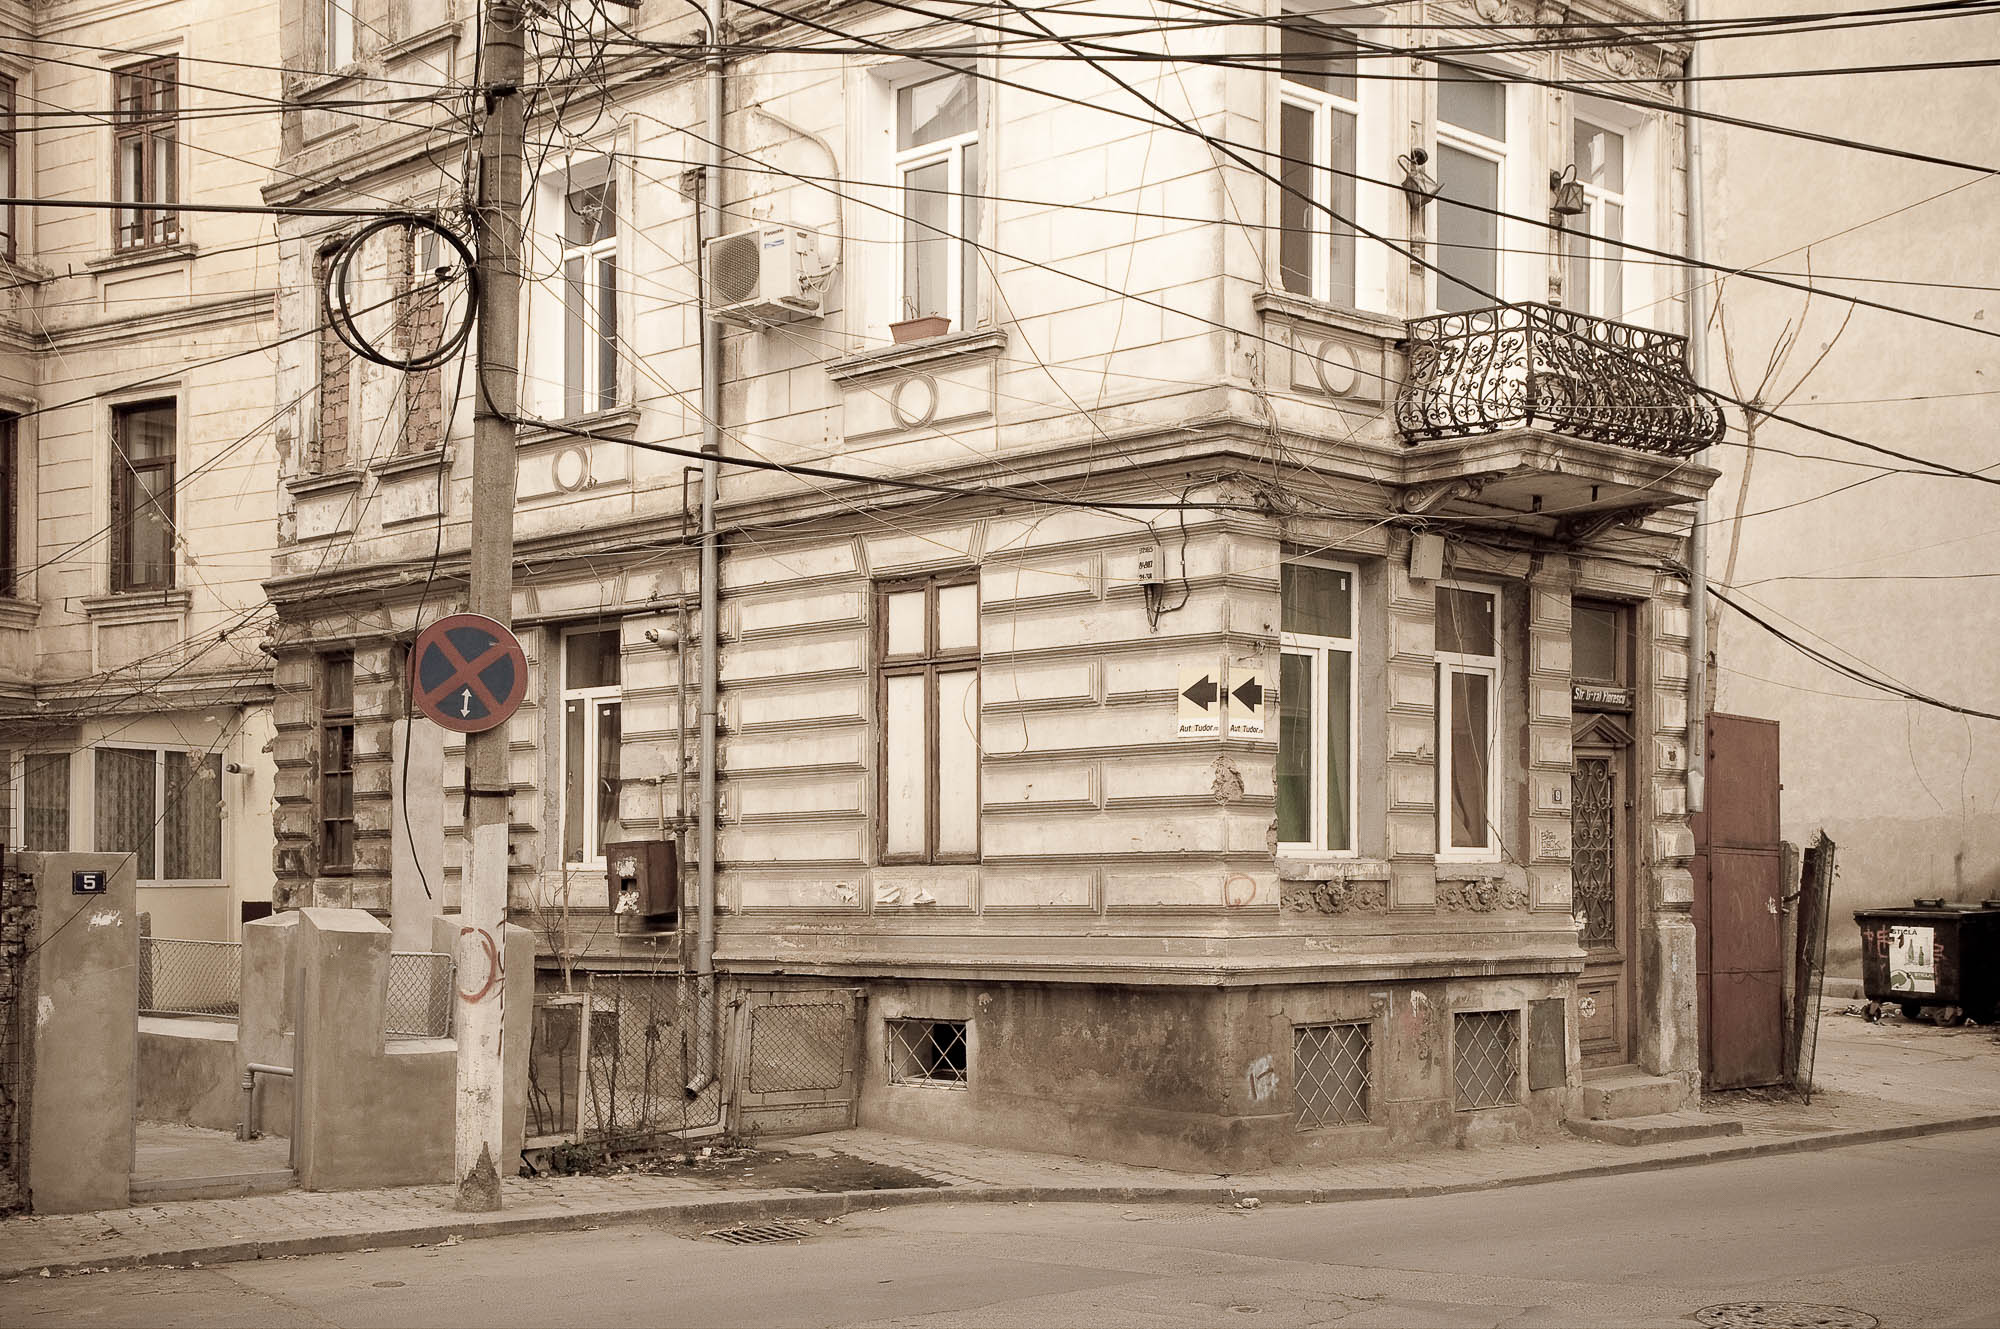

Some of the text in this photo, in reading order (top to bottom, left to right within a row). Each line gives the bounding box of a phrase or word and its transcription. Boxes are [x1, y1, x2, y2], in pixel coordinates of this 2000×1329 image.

[1574, 688, 1585, 700] Str.
[1602, 691, 1626, 704] Florescu
[83, 875, 96, 890] 5
